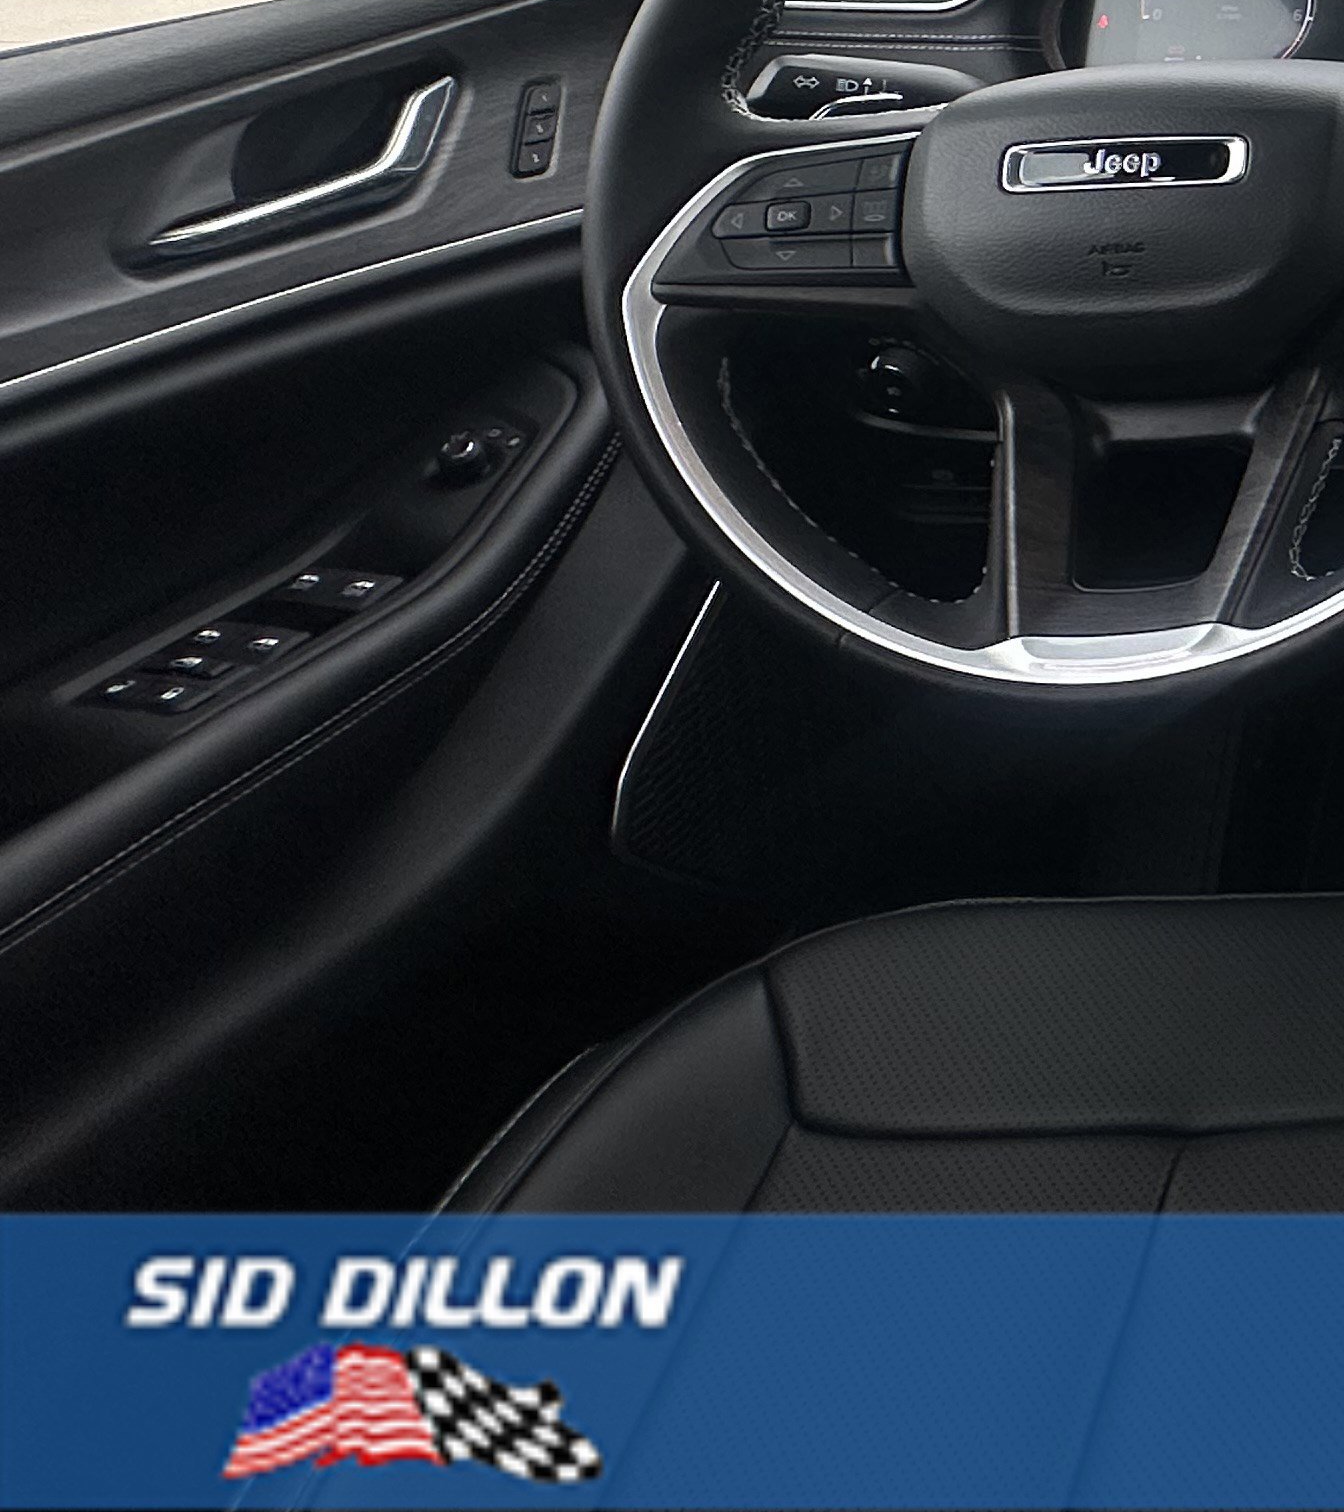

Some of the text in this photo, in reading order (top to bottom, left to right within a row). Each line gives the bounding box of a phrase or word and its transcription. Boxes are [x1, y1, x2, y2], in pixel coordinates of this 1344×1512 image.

[1152, 9, 1163, 21] 0
[1292, 10, 1303, 22] 6
[1082, 148, 1161, 177] Jeep
[776, 210, 798, 223] OK
